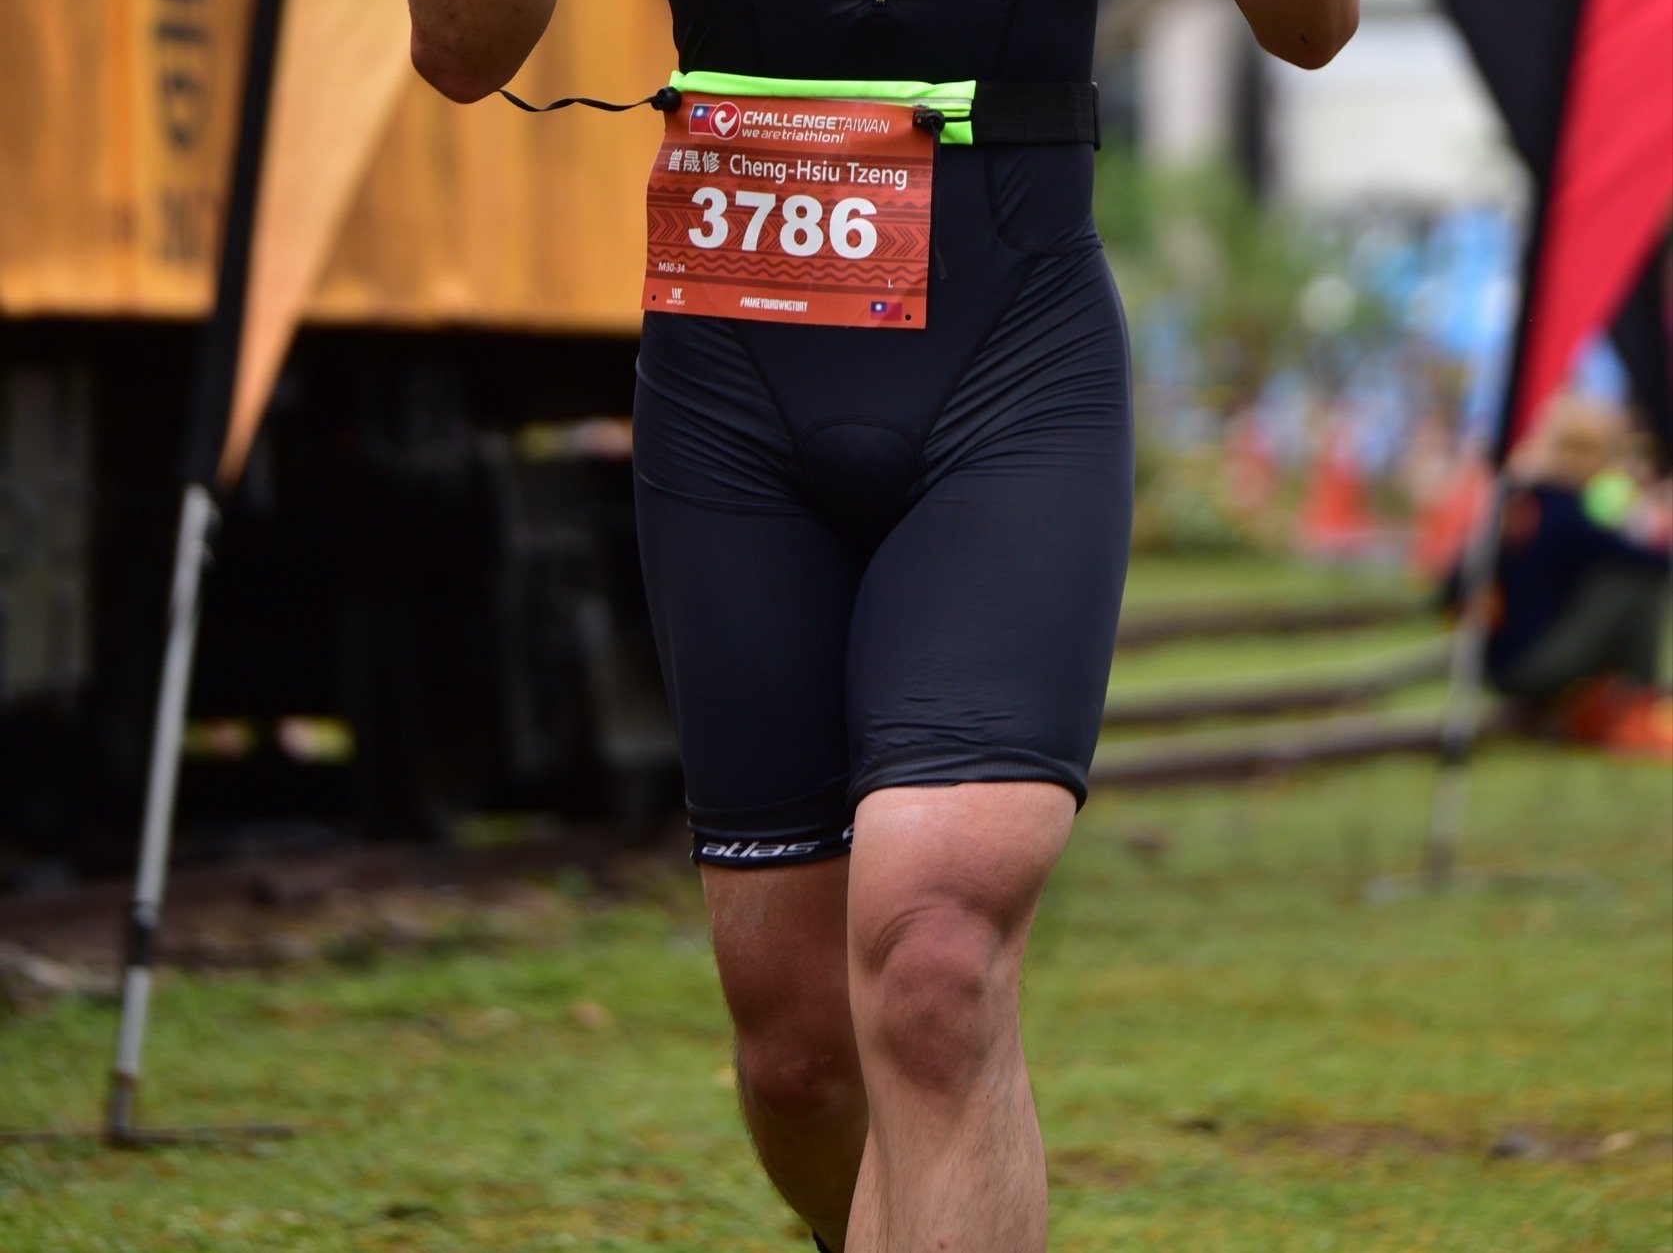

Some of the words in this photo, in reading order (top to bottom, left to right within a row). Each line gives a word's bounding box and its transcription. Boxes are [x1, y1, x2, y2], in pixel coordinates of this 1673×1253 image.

[742, 129, 759, 139] we
[763, 130, 781, 140] are
[781, 128, 845, 144] triathlon!
[729, 154, 840, 184] Cheng-Hsiu
[847, 162, 909, 190] Tzeng
[688, 186, 878, 259] 3786
[658, 262, 685, 273] M30-34
[887, 278, 893, 288] L
[701, 841, 820, 858] atlas
